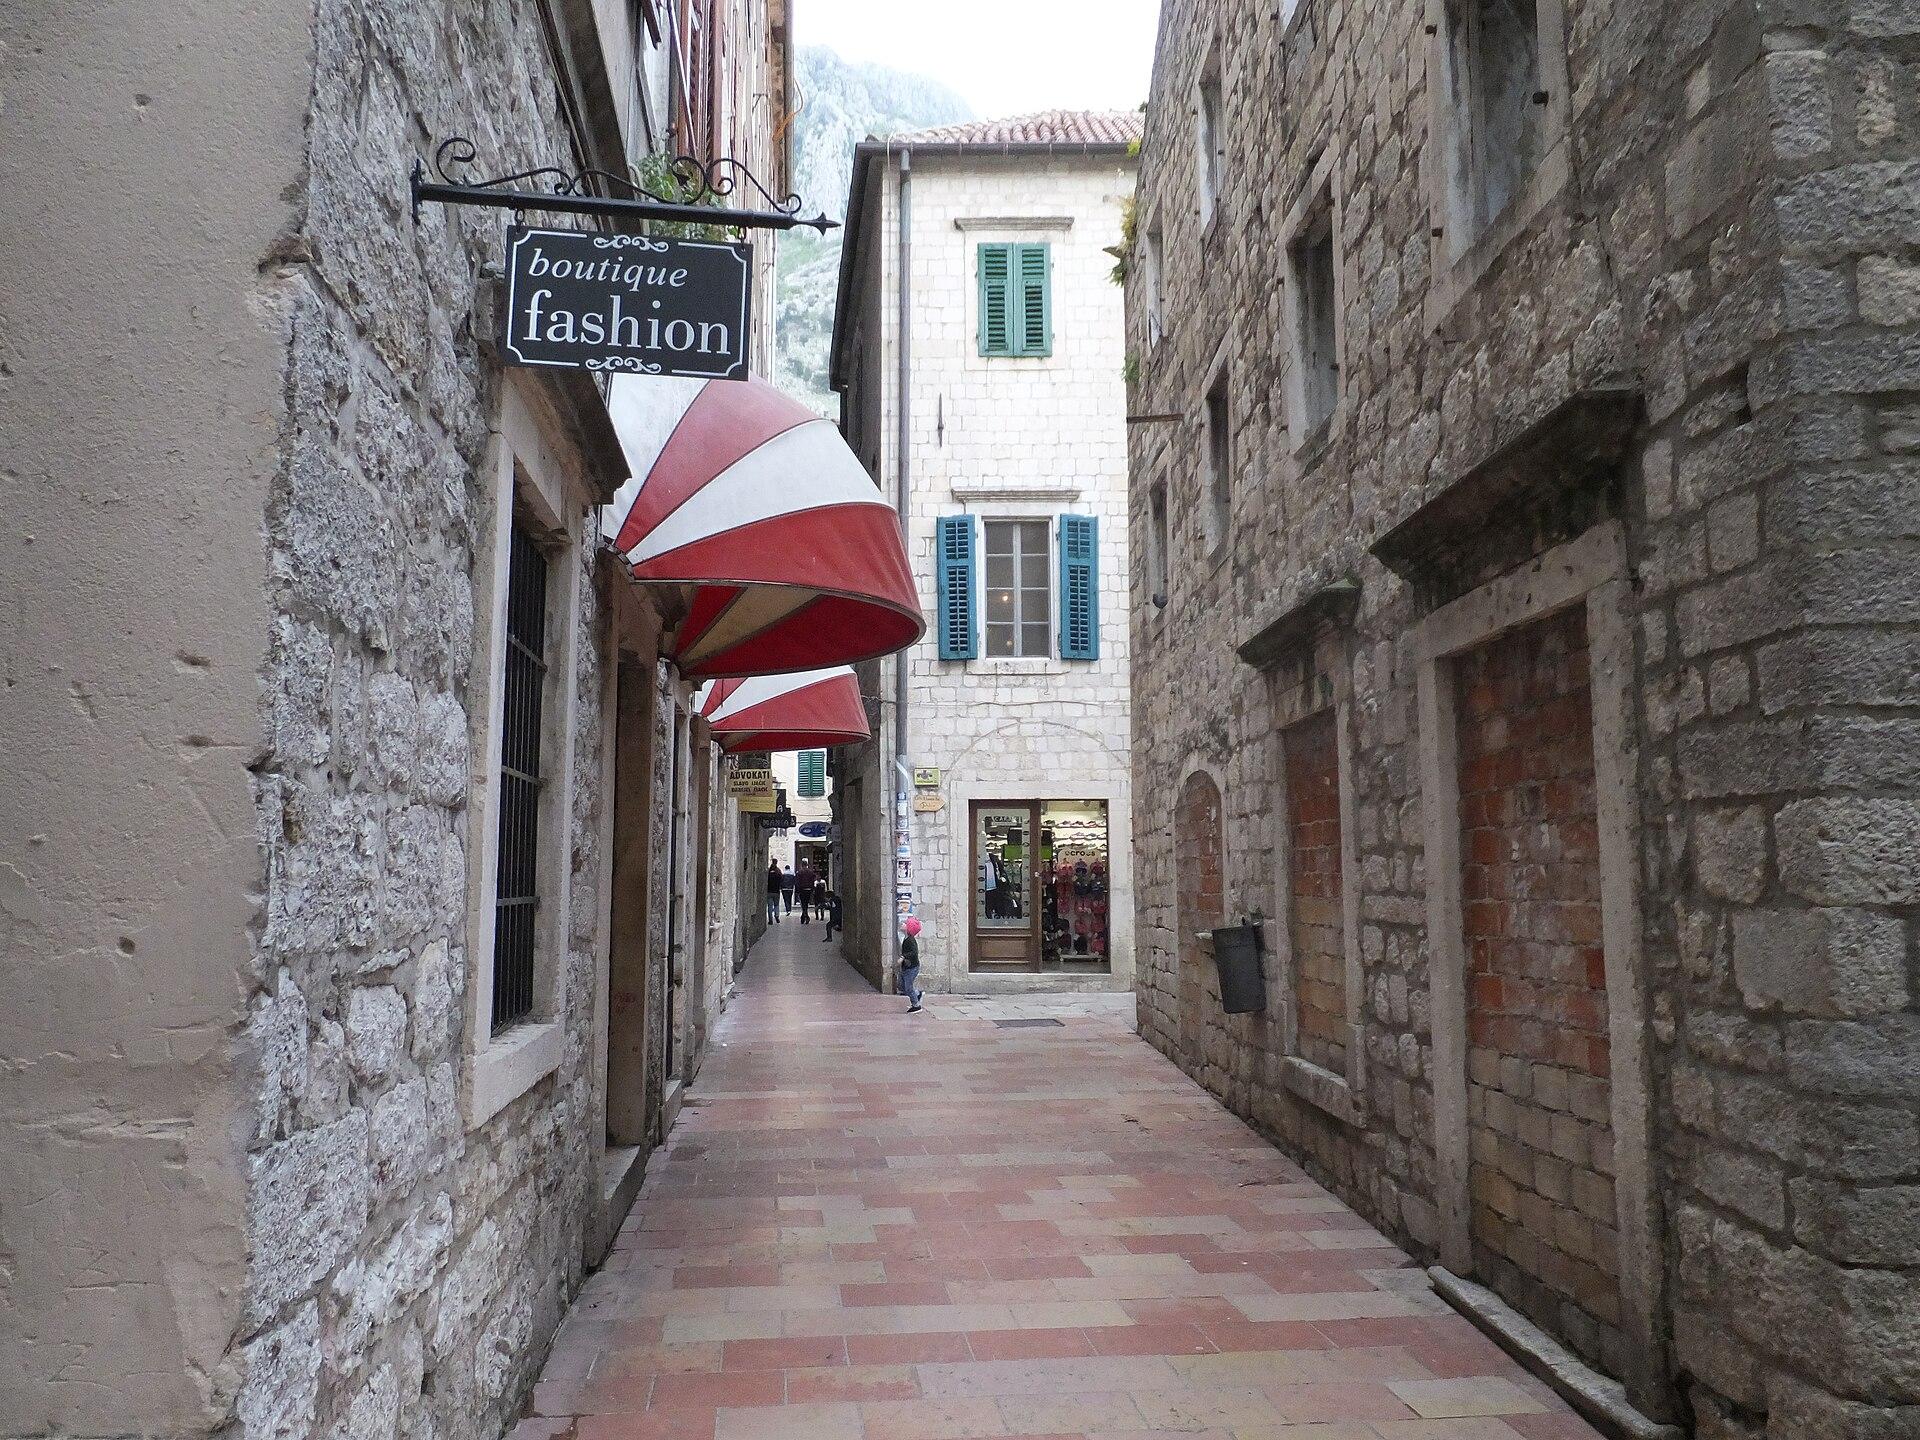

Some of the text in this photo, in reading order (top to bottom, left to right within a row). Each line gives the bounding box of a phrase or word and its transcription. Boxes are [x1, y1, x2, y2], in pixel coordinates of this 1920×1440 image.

[528, 247, 688, 292] boutique
[522, 289, 731, 355] fashion
[729, 771, 770, 780] ADVOKATI
